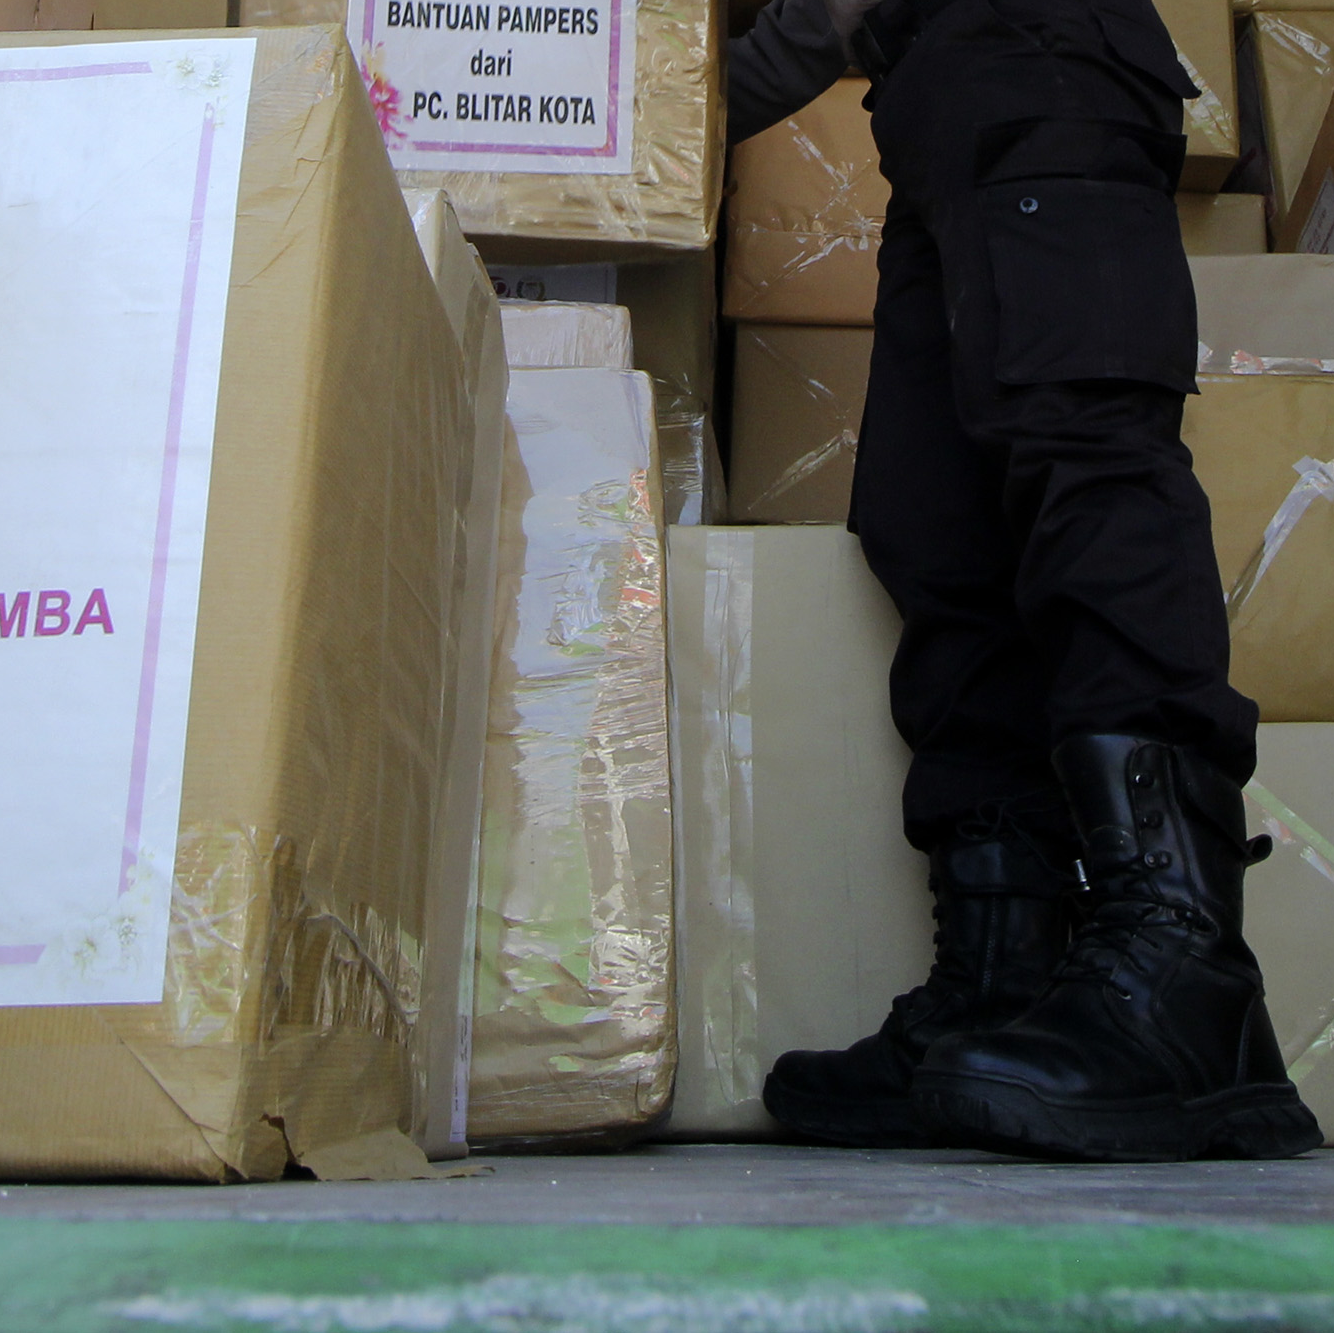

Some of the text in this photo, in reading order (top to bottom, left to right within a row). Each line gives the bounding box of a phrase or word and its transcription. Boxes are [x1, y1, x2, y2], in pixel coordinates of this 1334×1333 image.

[387, 1, 599, 35] BANTUAN PAMPERS
[470, 49, 513, 76] dari
[413, 92, 595, 125] PC. BLITAR KOTA
